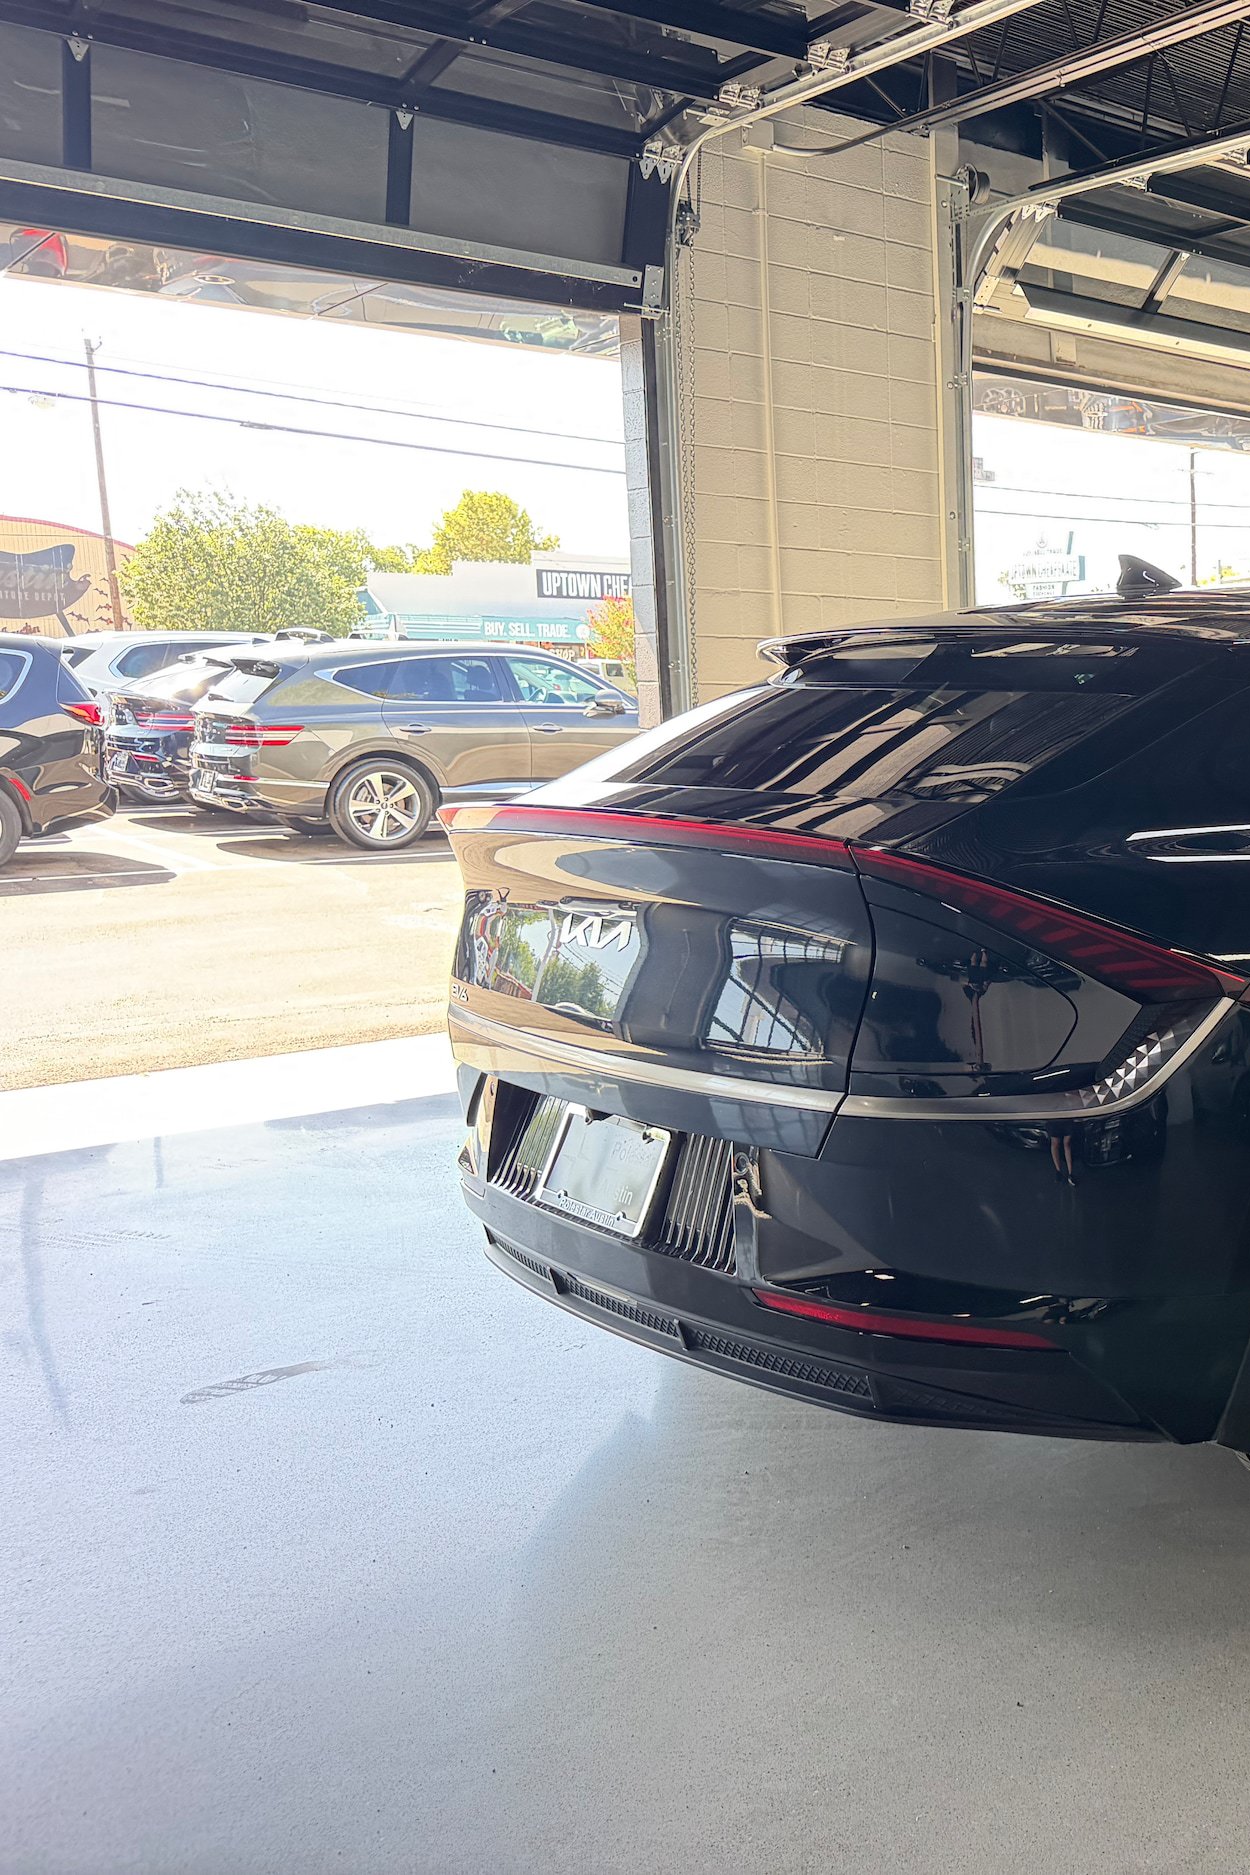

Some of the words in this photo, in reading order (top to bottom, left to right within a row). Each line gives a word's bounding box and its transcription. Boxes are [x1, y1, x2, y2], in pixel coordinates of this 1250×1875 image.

[541, 571, 602, 598] UPTOWN
[484, 620, 508, 637] BUY.
[559, 913, 634, 952] KIA
[559, 1198, 591, 1218] Polestar
[589, 1209, 616, 1227] Austin
